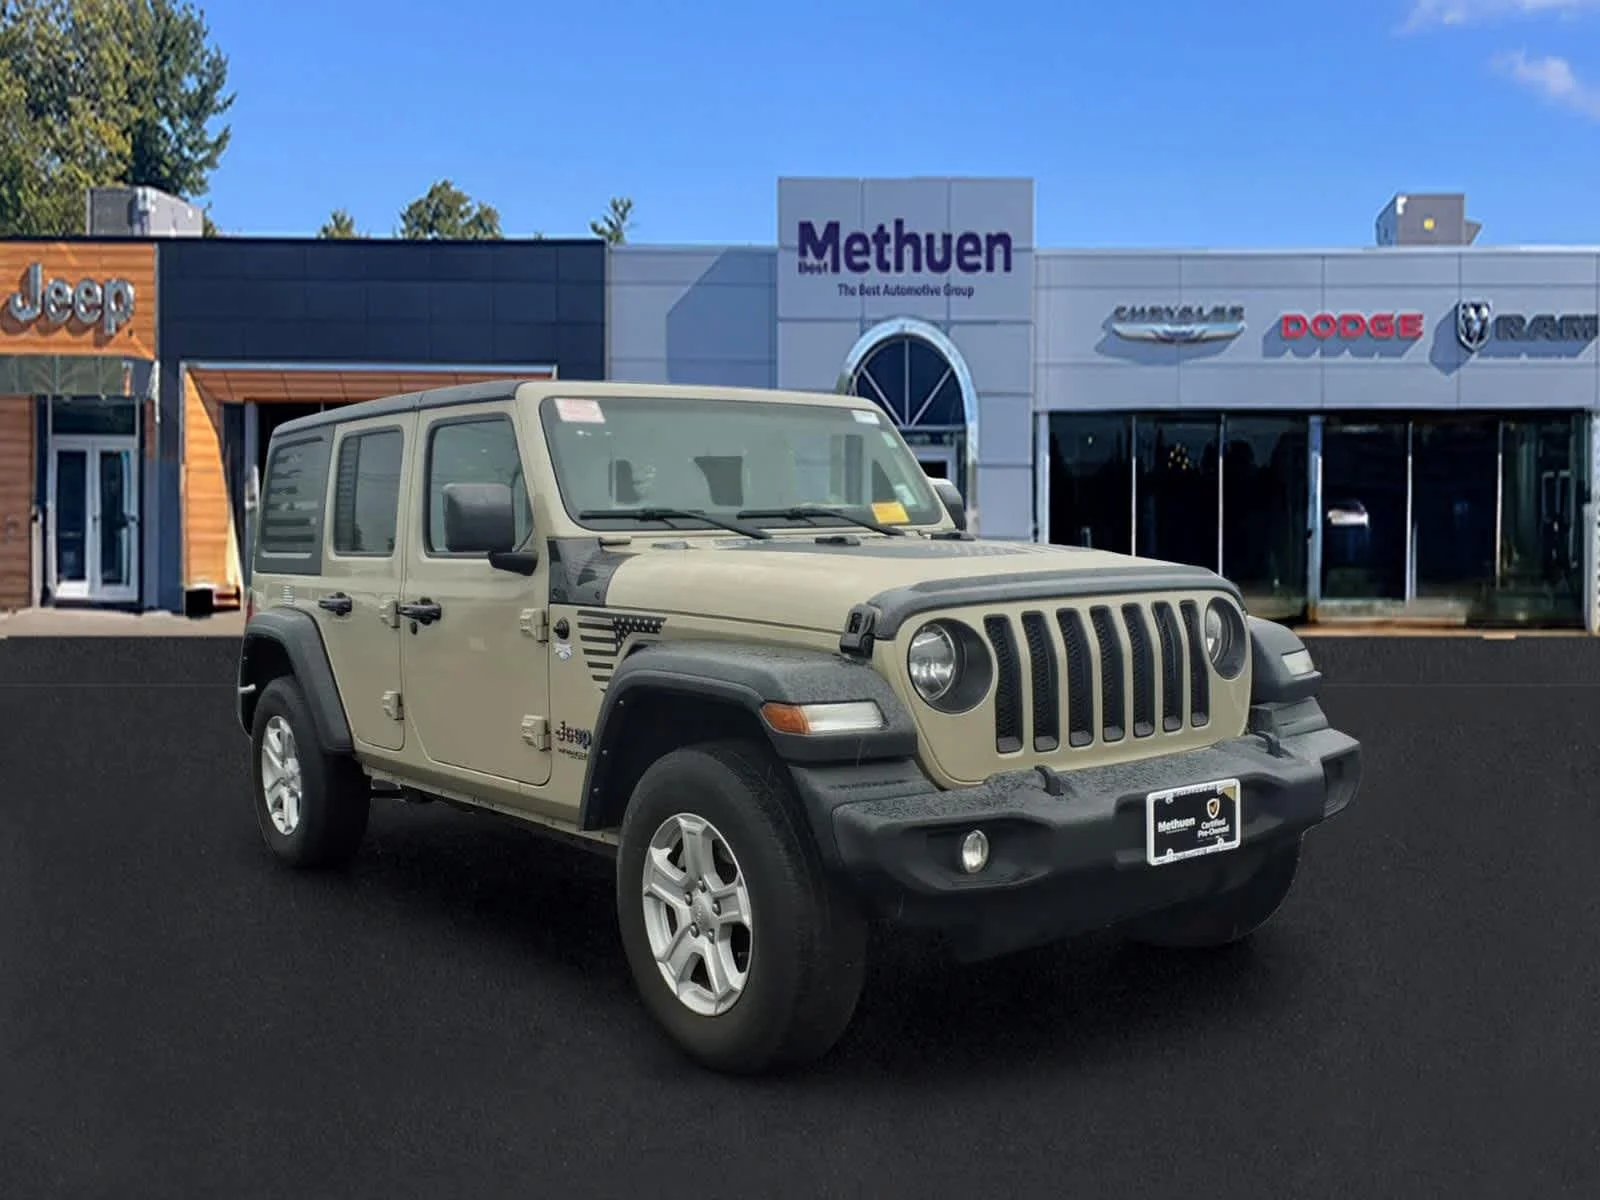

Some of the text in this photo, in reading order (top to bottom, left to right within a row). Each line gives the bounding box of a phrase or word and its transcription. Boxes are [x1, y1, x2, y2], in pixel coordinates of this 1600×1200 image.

[798, 217, 1012, 274] Methuen
[9, 262, 135, 336] Jeep
[838, 283, 974, 299] The Best Automotive Group
[1114, 305, 1245, 321] CHRYSLER
[1281, 314, 1424, 340] DODGE
[1495, 314, 1598, 341] RAM
[1158, 817, 1196, 833] Methuen
[1198, 824, 1230, 838] Pre-Owned
[1201, 817, 1226, 830] Certified
